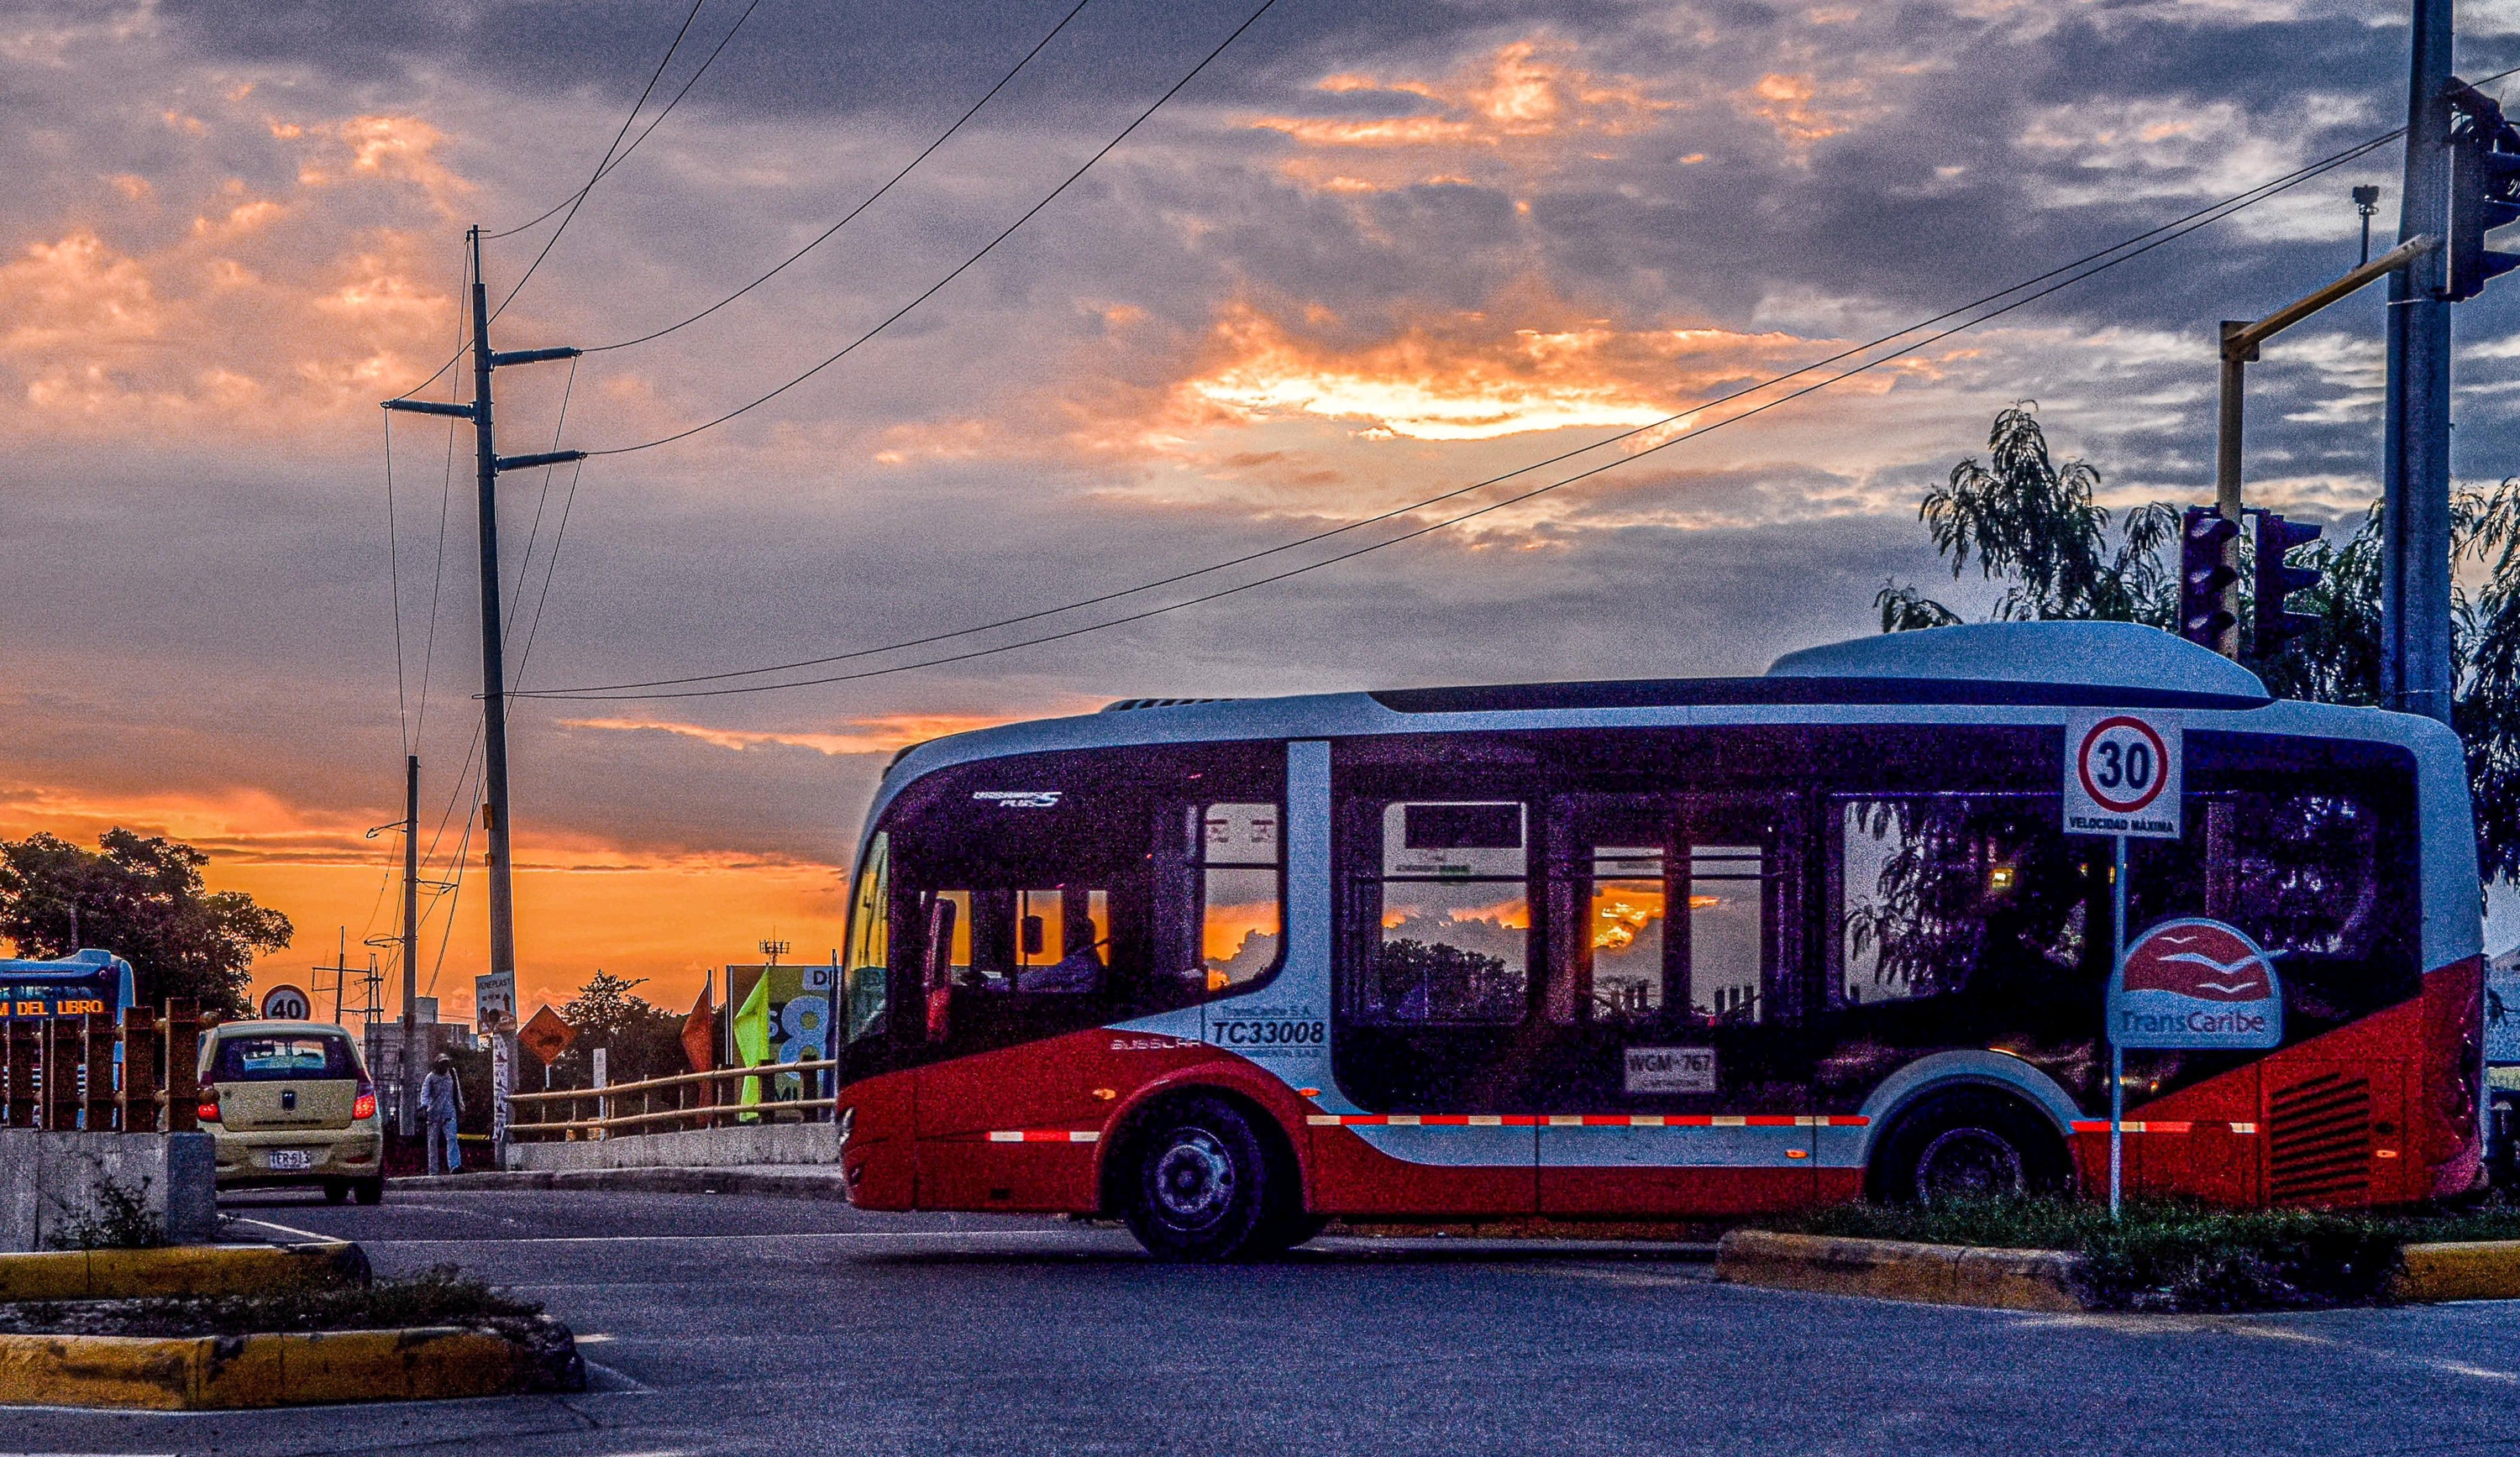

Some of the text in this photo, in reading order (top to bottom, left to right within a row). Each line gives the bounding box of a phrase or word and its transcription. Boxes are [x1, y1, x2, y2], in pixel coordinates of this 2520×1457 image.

[2097, 741, 2150, 789] 30
[2069, 816, 2129, 830] VELOCIDAD
[17, 1001, 49, 1015] DEL
[57, 999, 103, 1014] LIBRO
[270, 999, 302, 1019] 40
[2122, 1010, 2265, 1033] TransCaribe
[1212, 1021, 1325, 1044] TC33008
